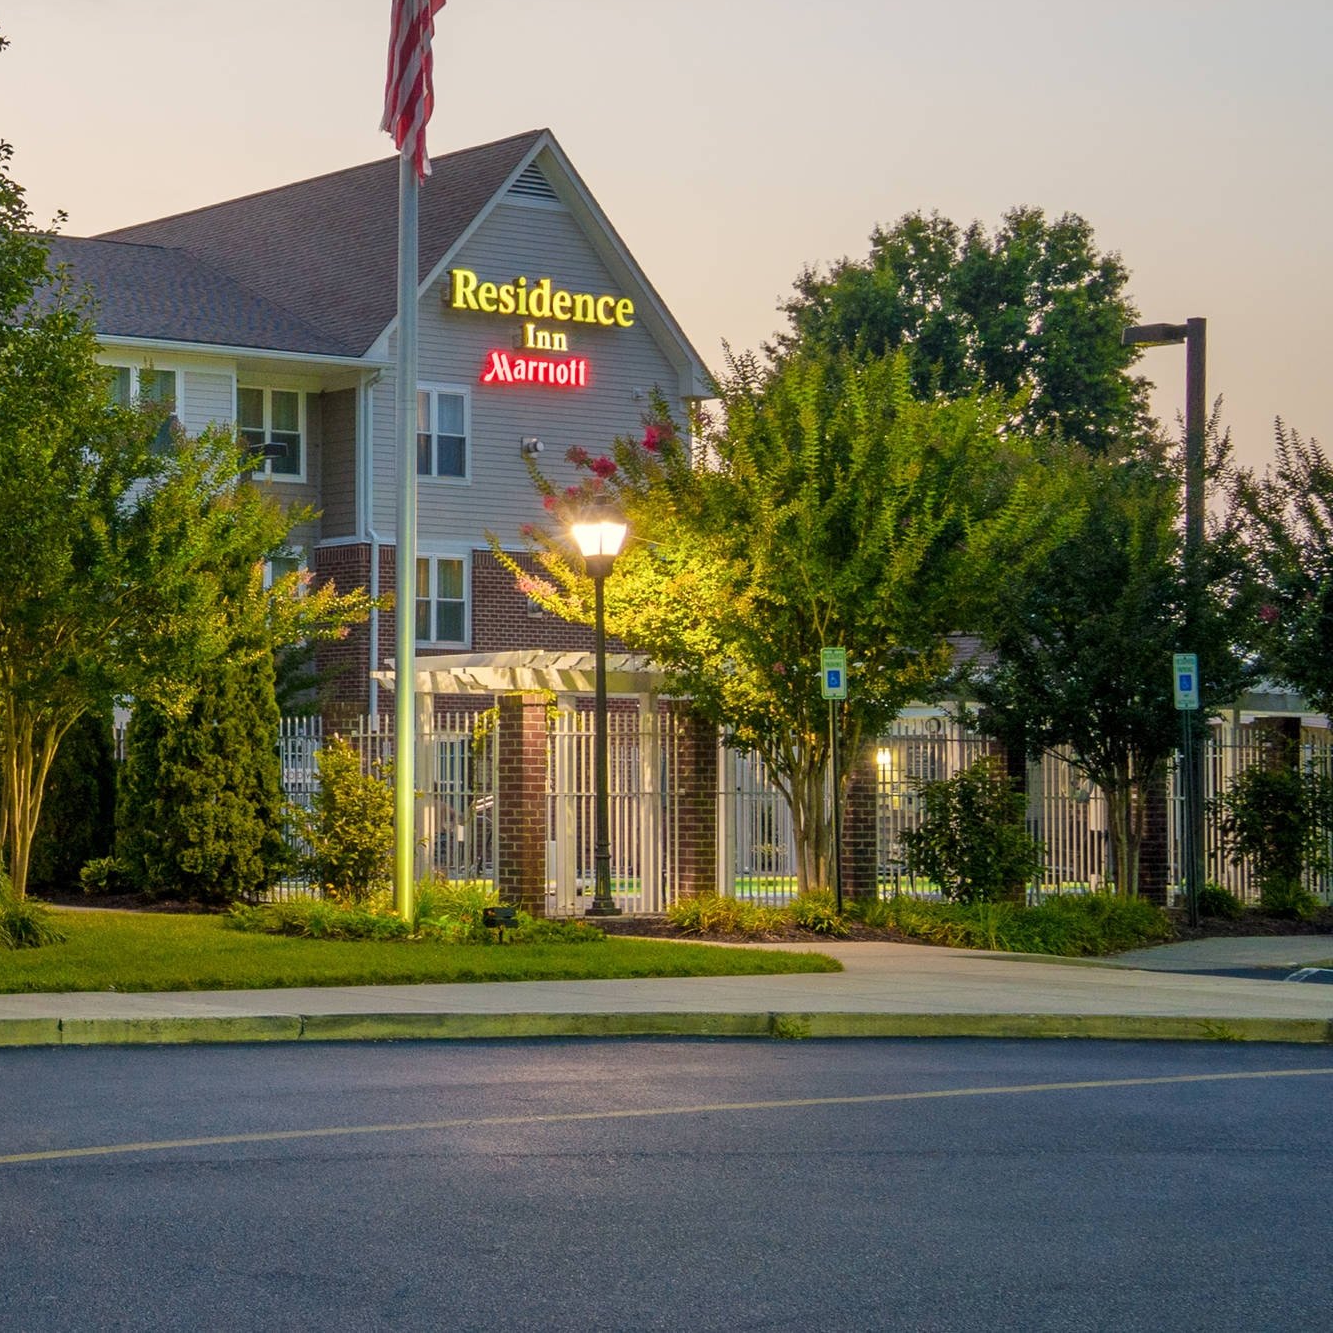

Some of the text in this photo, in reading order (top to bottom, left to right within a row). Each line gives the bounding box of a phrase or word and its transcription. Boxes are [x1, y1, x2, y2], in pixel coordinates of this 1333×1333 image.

[449, 268, 635, 327] Residence
[523, 323, 569, 352] Inn
[483, 351, 586, 387] Marriott
